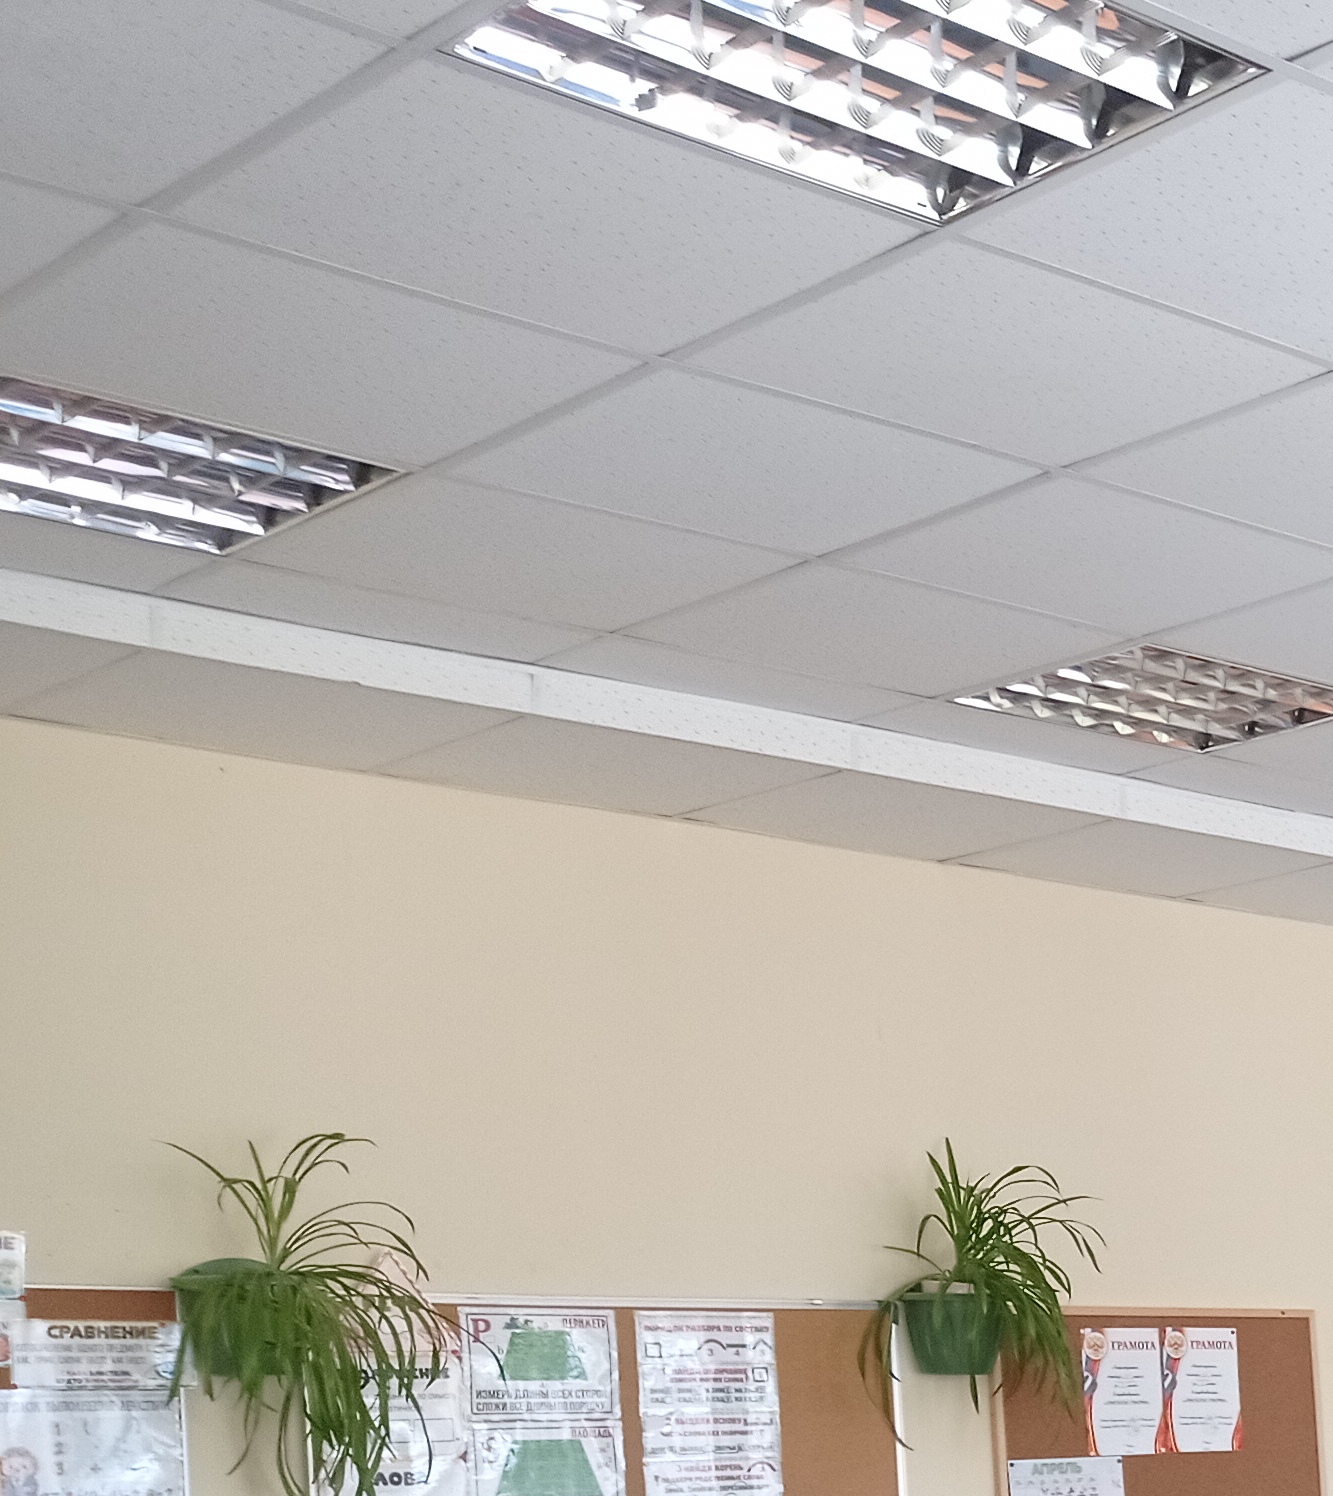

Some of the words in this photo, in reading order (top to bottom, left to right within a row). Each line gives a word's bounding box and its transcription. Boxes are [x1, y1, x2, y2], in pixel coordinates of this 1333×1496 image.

[562, 1318, 607, 1329] ПЕРИМЕТР
[47, 1325, 160, 1340] СРАВНЕНИЕ
[1111, 1341, 1156, 1351] ГРАМОТА
[1190, 1340, 1234, 1350] ГРАМОТА
[476, 1401, 508, 1412] СЛОЖИ
[1031, 1462, 1083, 1476] АПРЕЛЬ
